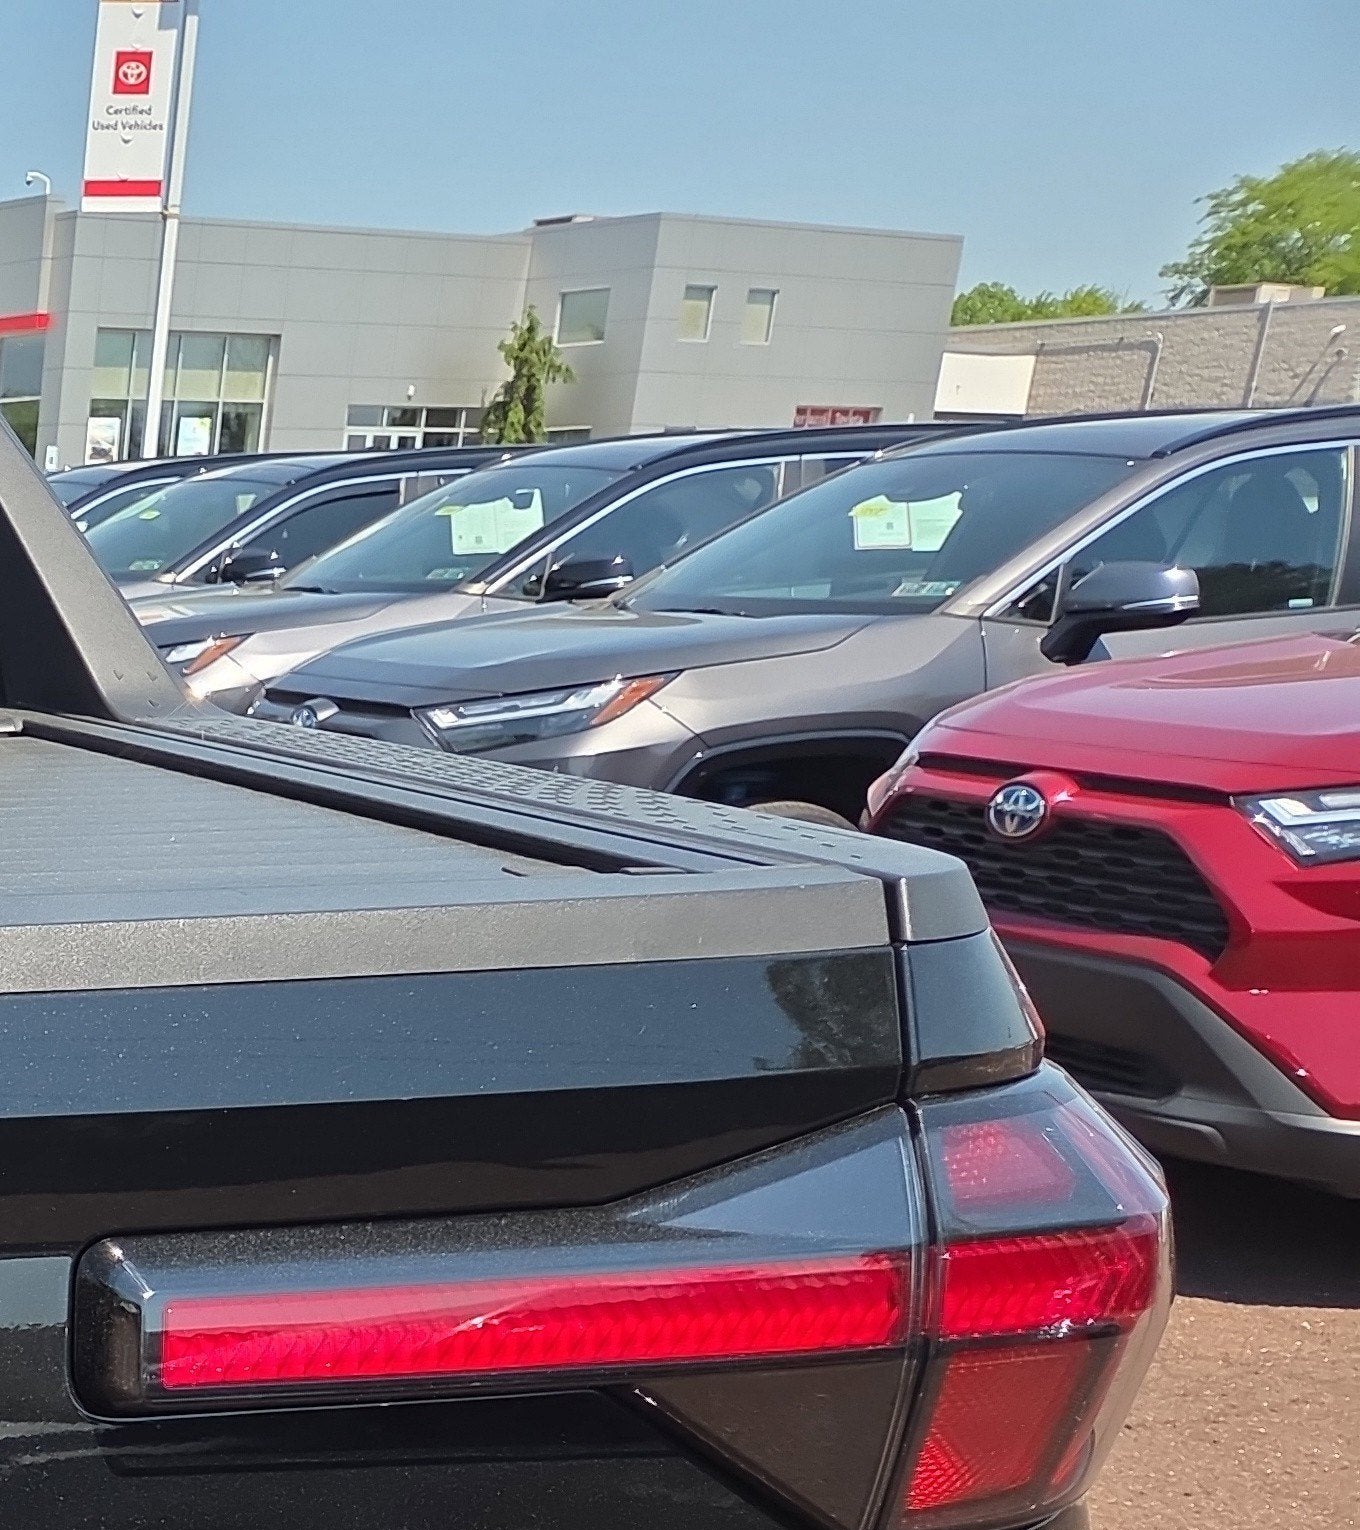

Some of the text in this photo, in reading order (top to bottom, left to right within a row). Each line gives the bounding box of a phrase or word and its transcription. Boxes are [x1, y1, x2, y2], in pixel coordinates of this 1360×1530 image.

[105, 105, 152, 116] Certified
[92, 120, 164, 131] Used Vehicles
